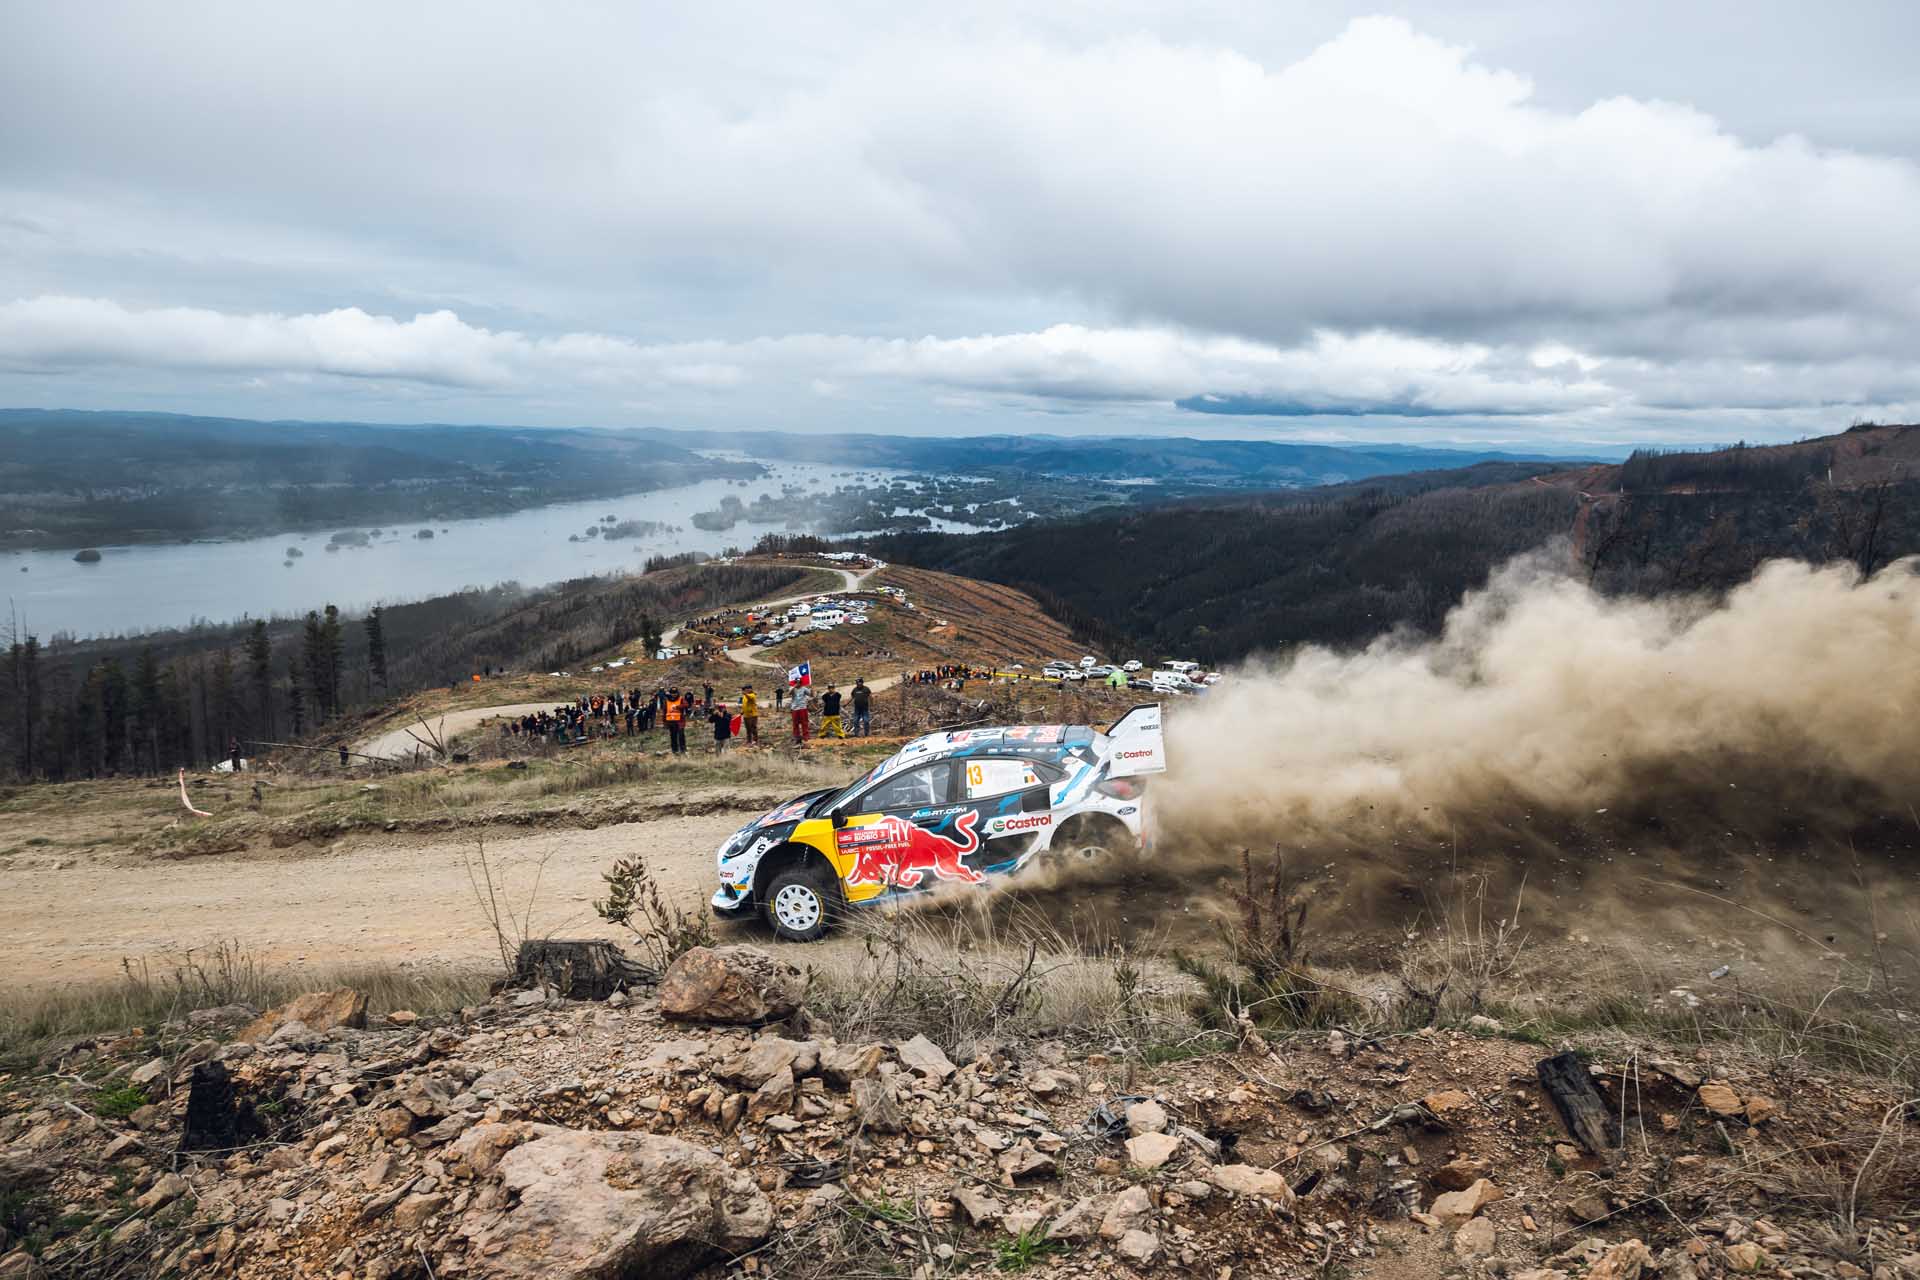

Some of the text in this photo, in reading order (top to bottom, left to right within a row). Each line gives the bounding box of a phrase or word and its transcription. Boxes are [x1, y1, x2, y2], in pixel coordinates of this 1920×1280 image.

[1123, 749, 1153, 759] Castrol
[967, 764, 983, 786] 13
[1006, 814, 1052, 830] Castrol
[889, 821, 911, 842] HY
